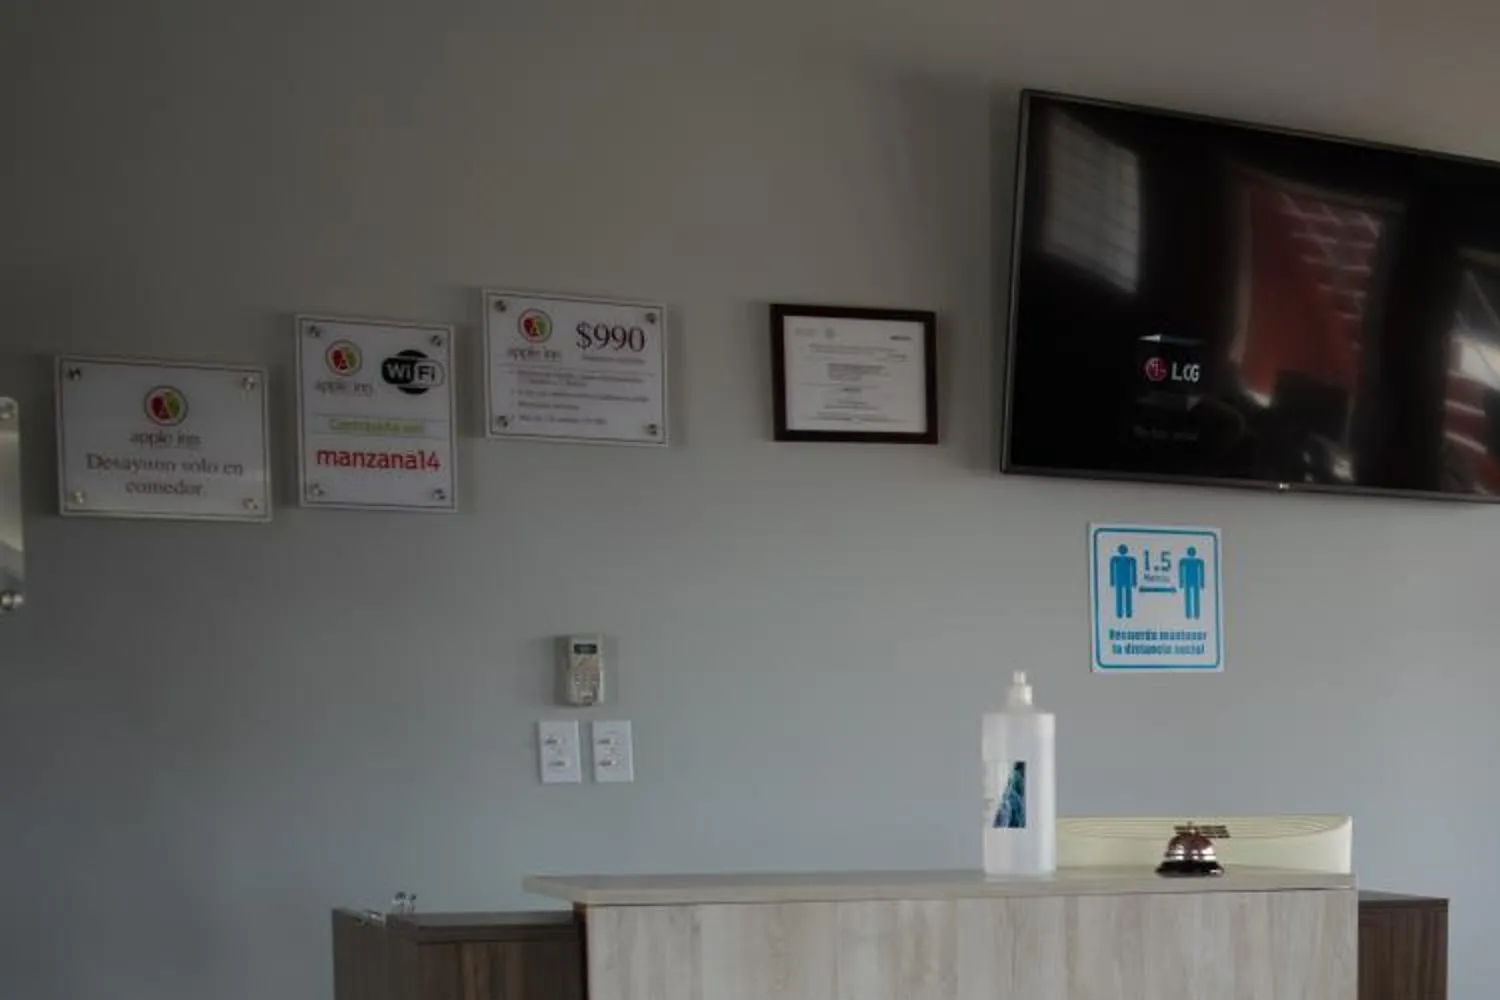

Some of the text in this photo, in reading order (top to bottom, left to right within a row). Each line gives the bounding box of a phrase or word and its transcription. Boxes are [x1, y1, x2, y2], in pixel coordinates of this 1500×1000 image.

[574, 320, 646, 353] $990
[222, 462, 244, 476] en
[316, 449, 442, 471] manzana14
[1143, 550, 1172, 572] 1.5
